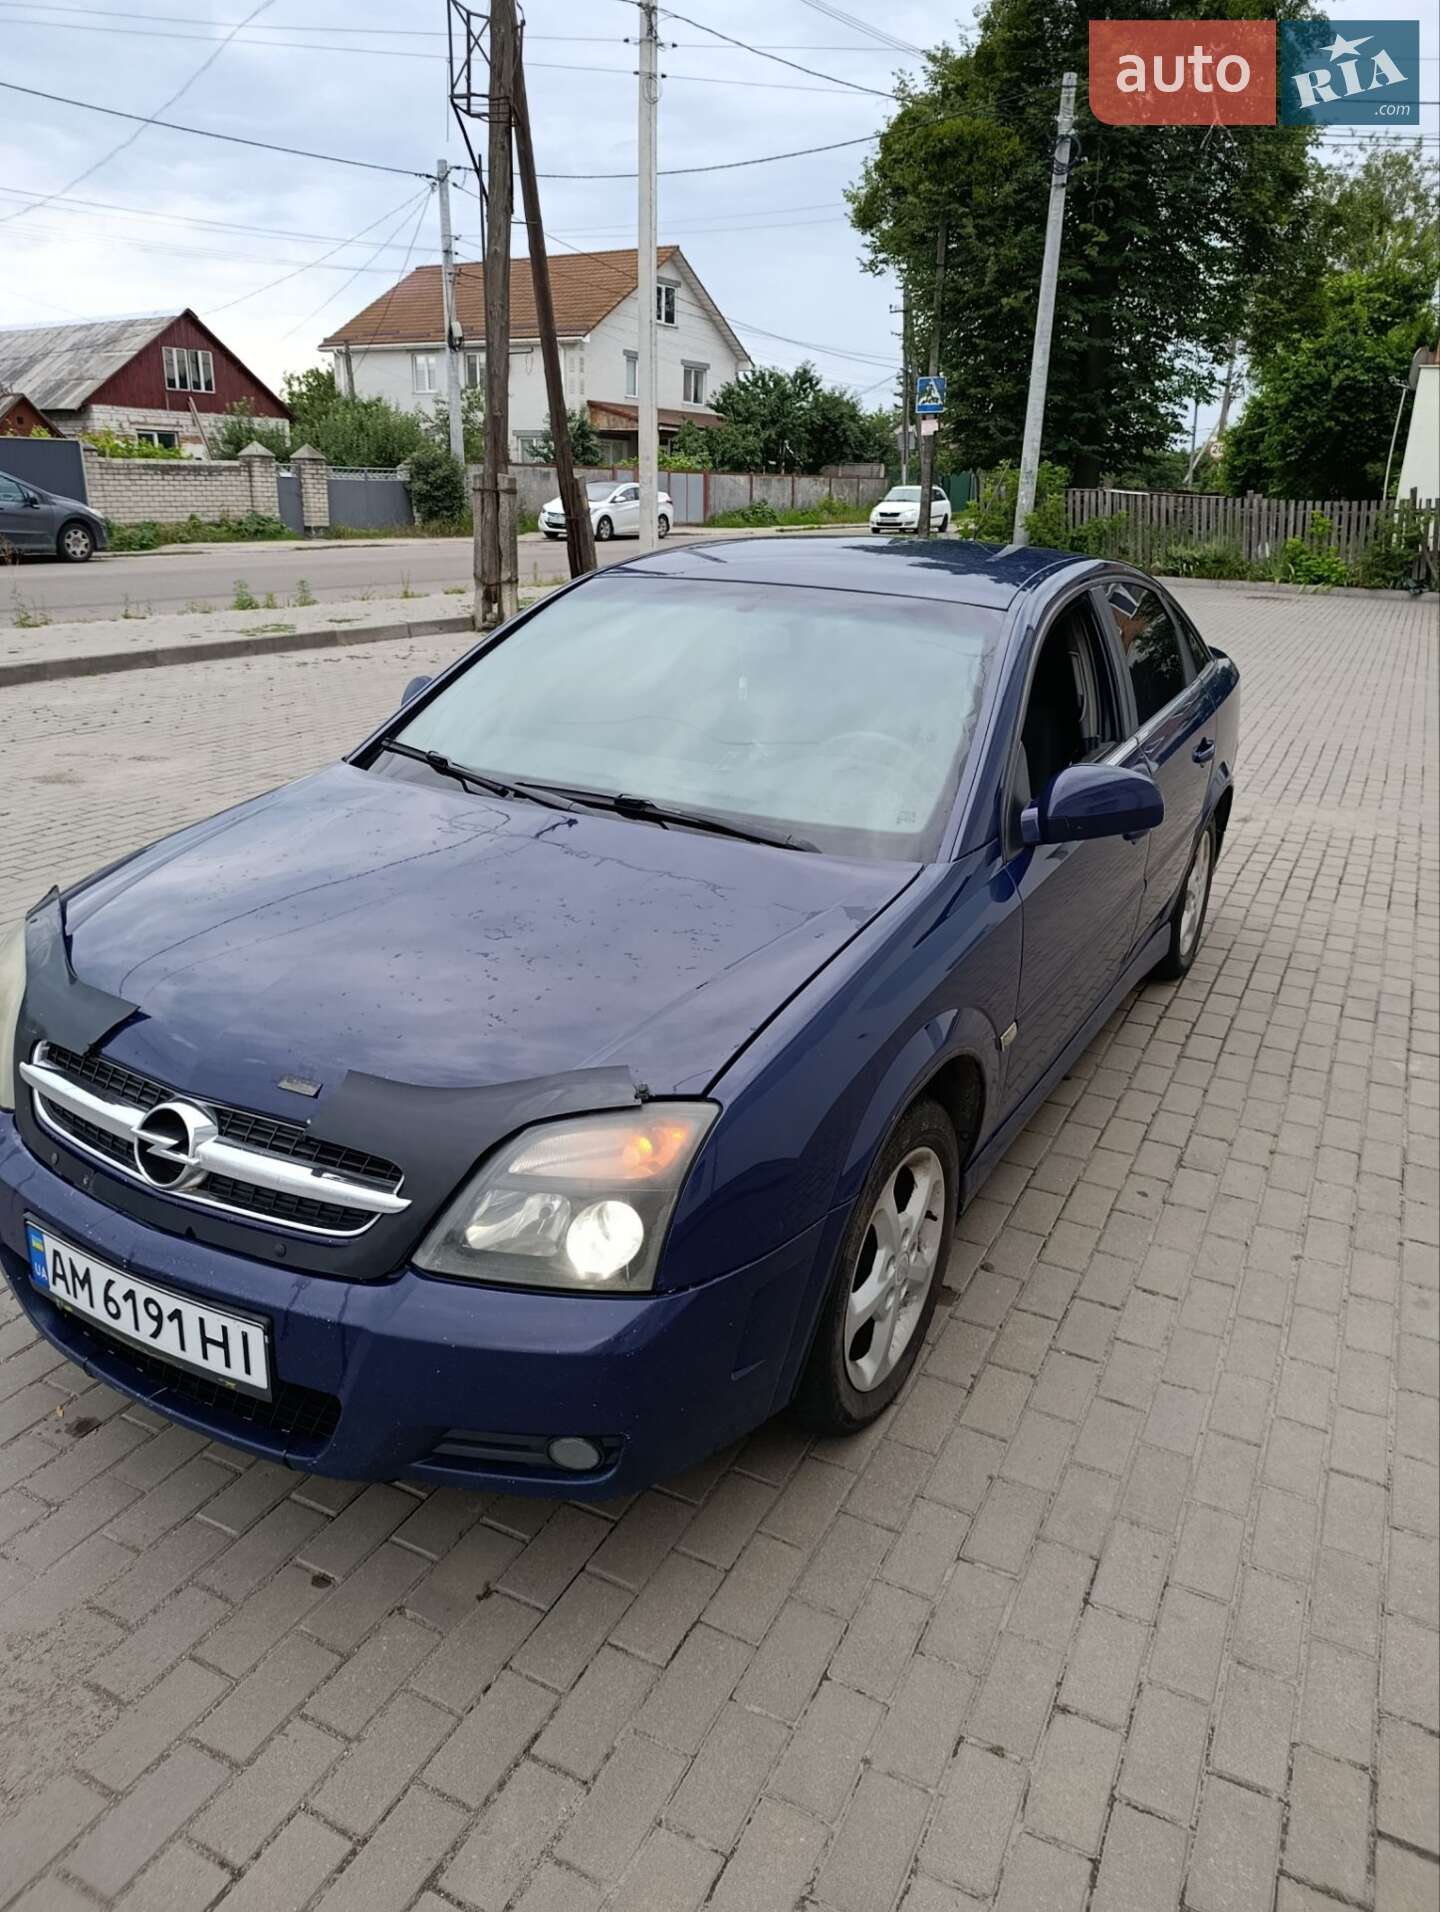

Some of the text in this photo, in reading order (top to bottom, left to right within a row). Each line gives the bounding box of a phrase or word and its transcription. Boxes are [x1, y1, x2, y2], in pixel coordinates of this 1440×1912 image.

[34, 1262, 48, 1280] UA
[52, 1248, 95, 1309] AM
[103, 1278, 187, 1353] 6191
